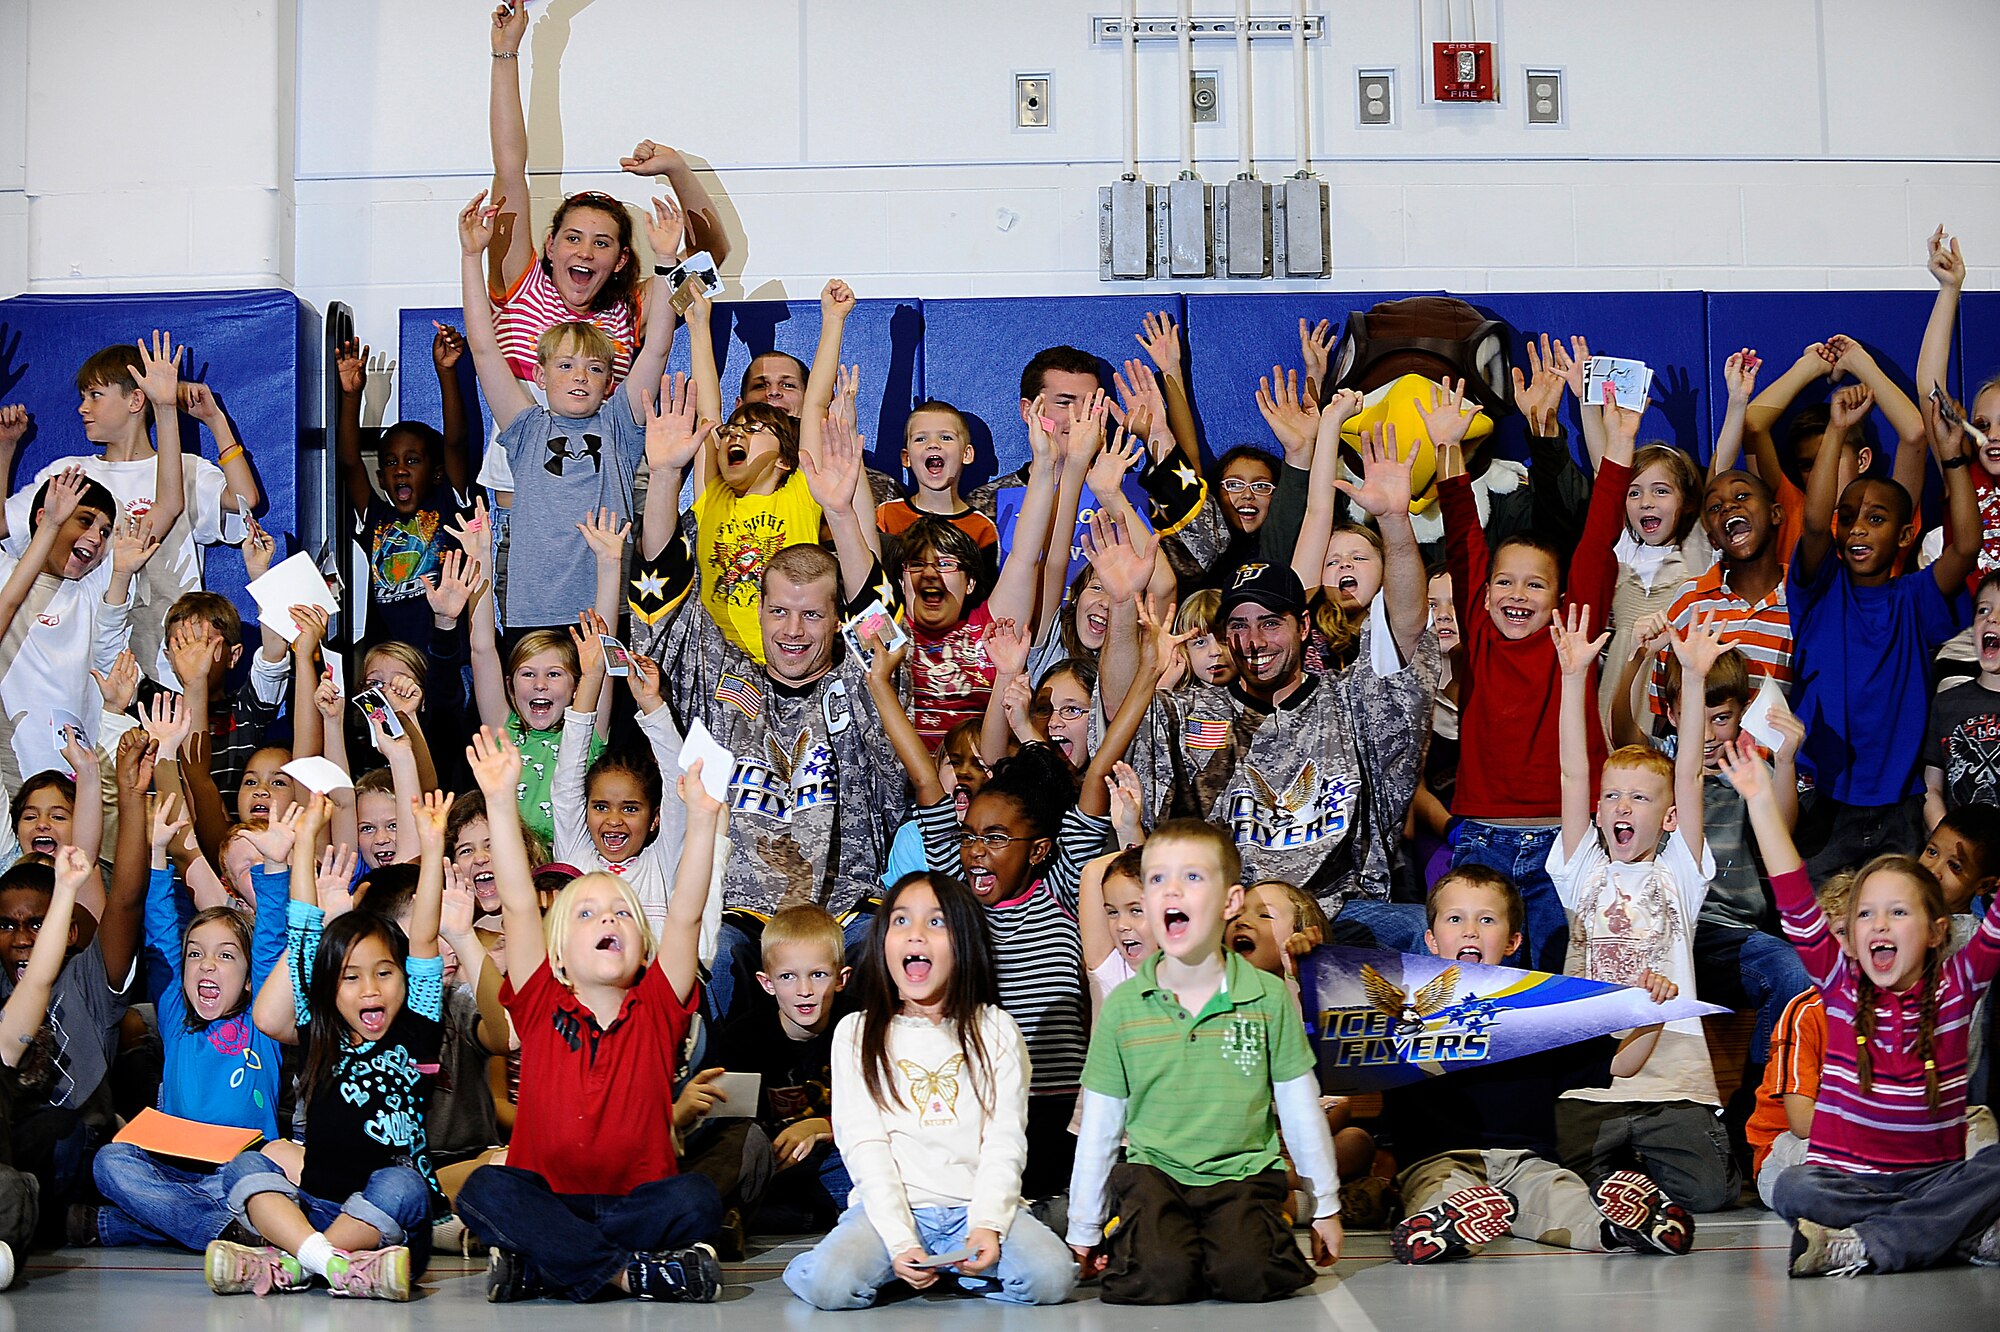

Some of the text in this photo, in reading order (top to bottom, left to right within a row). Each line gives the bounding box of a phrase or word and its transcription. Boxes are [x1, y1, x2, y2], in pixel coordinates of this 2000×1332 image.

[1450, 90, 1478, 98] FIRE
[822, 678, 852, 736] C
[729, 763, 781, 794] ICE
[736, 780, 838, 819] FLYRS
[1235, 807, 1345, 847] FLYERS
[1321, 1010, 1390, 1041] ICE
[1334, 1033, 1491, 1068] FLYERS
